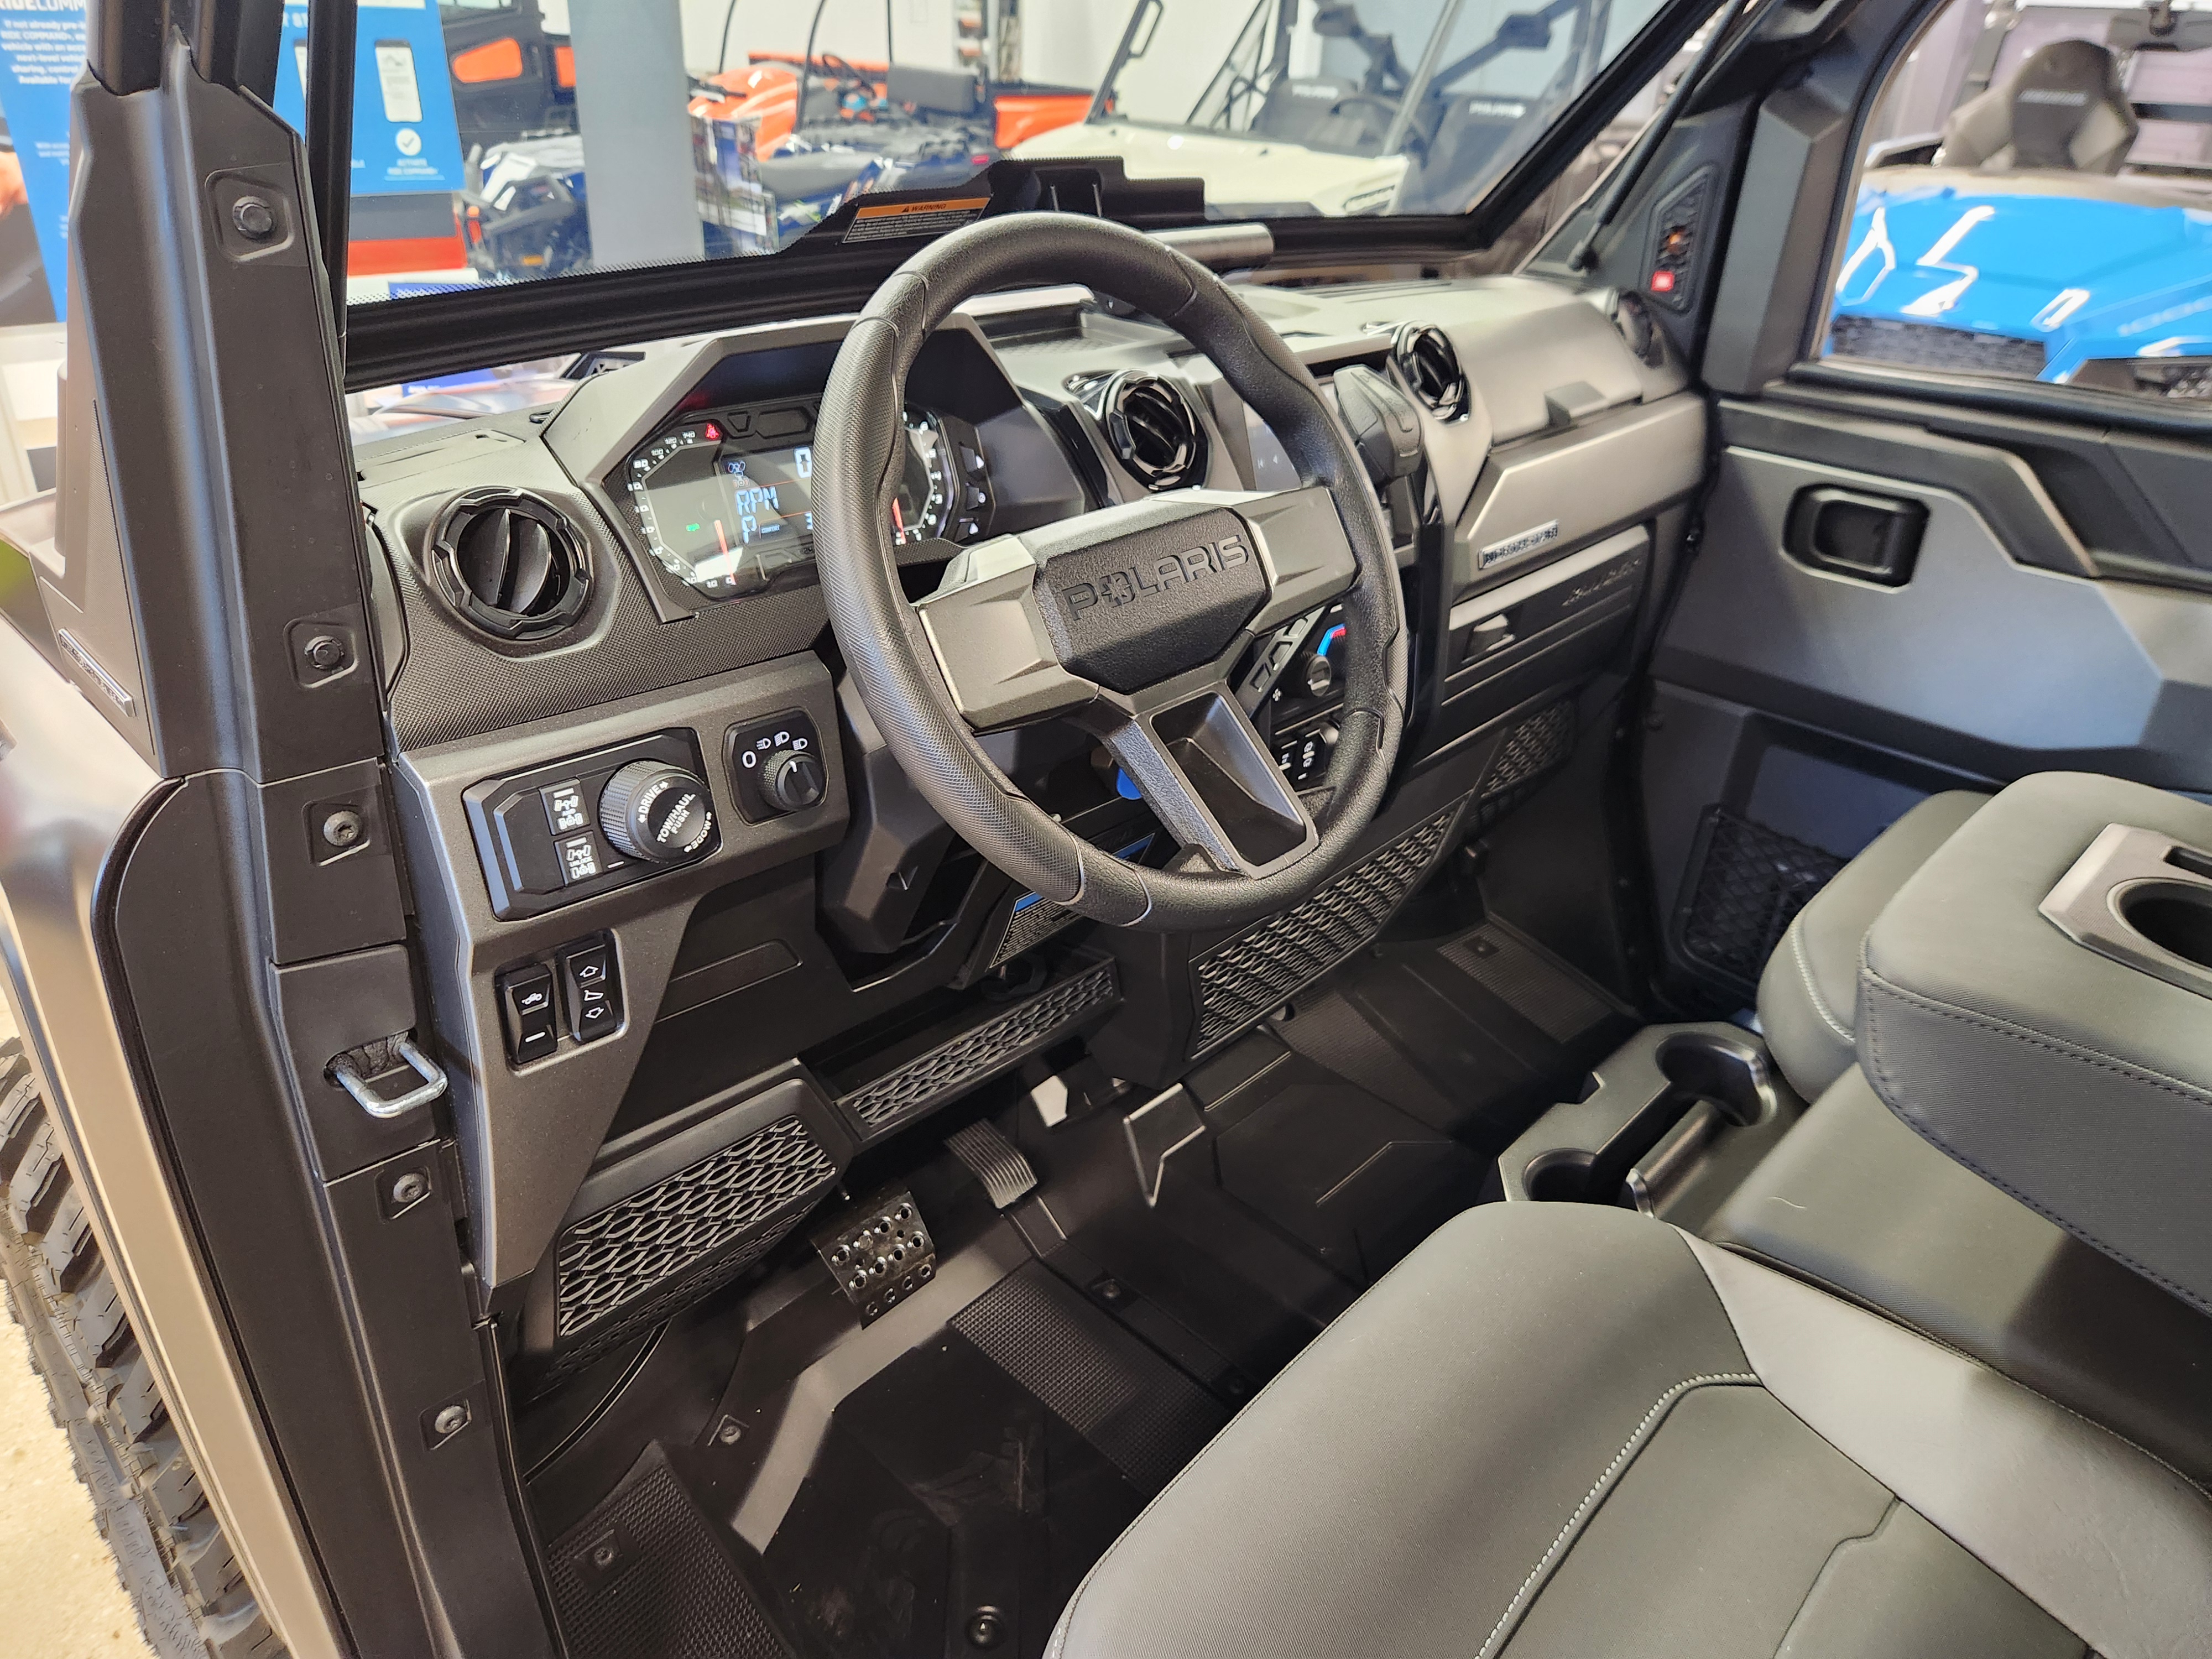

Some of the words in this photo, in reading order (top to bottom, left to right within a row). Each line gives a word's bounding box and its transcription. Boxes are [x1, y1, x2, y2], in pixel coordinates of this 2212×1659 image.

[912, 204, 947, 212] WARNING
[736, 486, 779, 516] RPM
[742, 515, 757, 544] P
[1062, 534, 1249, 621] POLARIS
[638, 784, 661, 814] DRIVE
[656, 794, 696, 843] TOW/HAUL
[671, 810, 690, 834] PUSH
[691, 820, 712, 849] MODE
